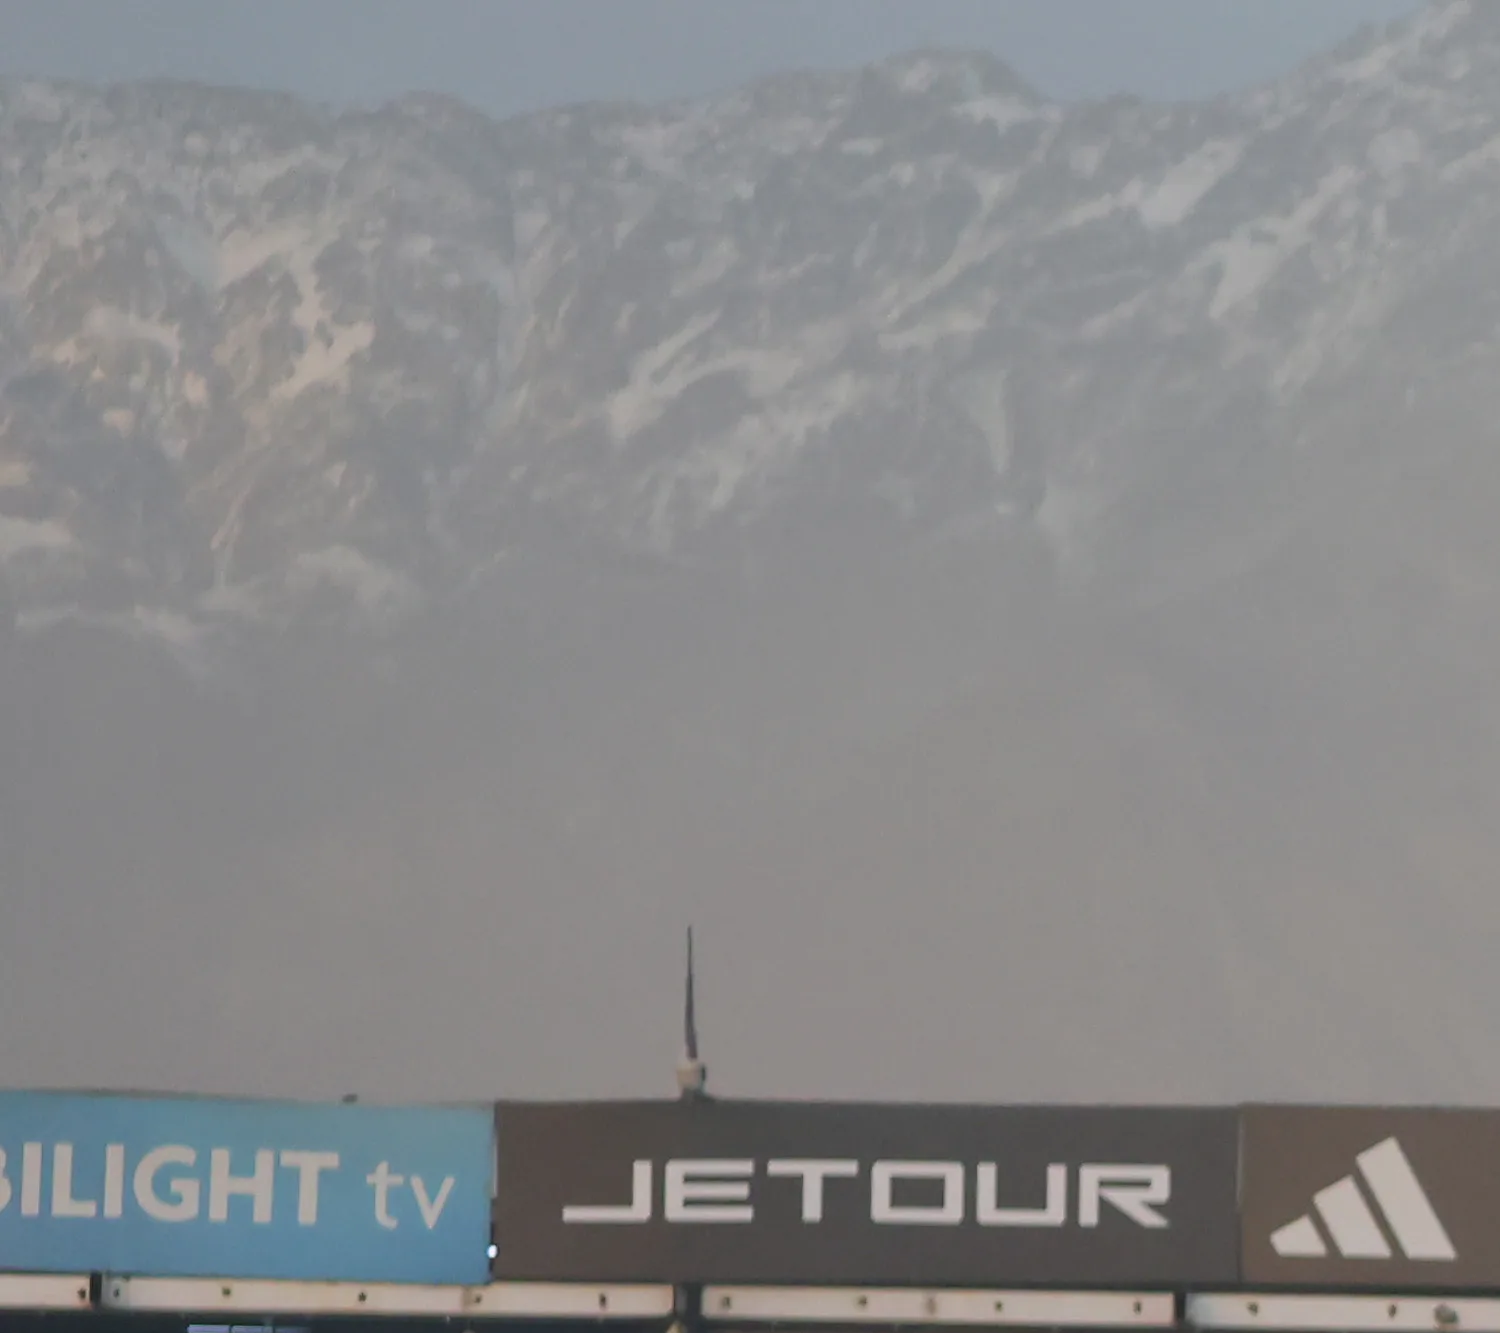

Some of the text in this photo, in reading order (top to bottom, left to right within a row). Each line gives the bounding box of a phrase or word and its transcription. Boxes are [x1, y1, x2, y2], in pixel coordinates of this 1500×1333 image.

[0, 1142, 457, 1232] ILIGHT tv
[562, 1157, 1174, 1230] JETOUR
